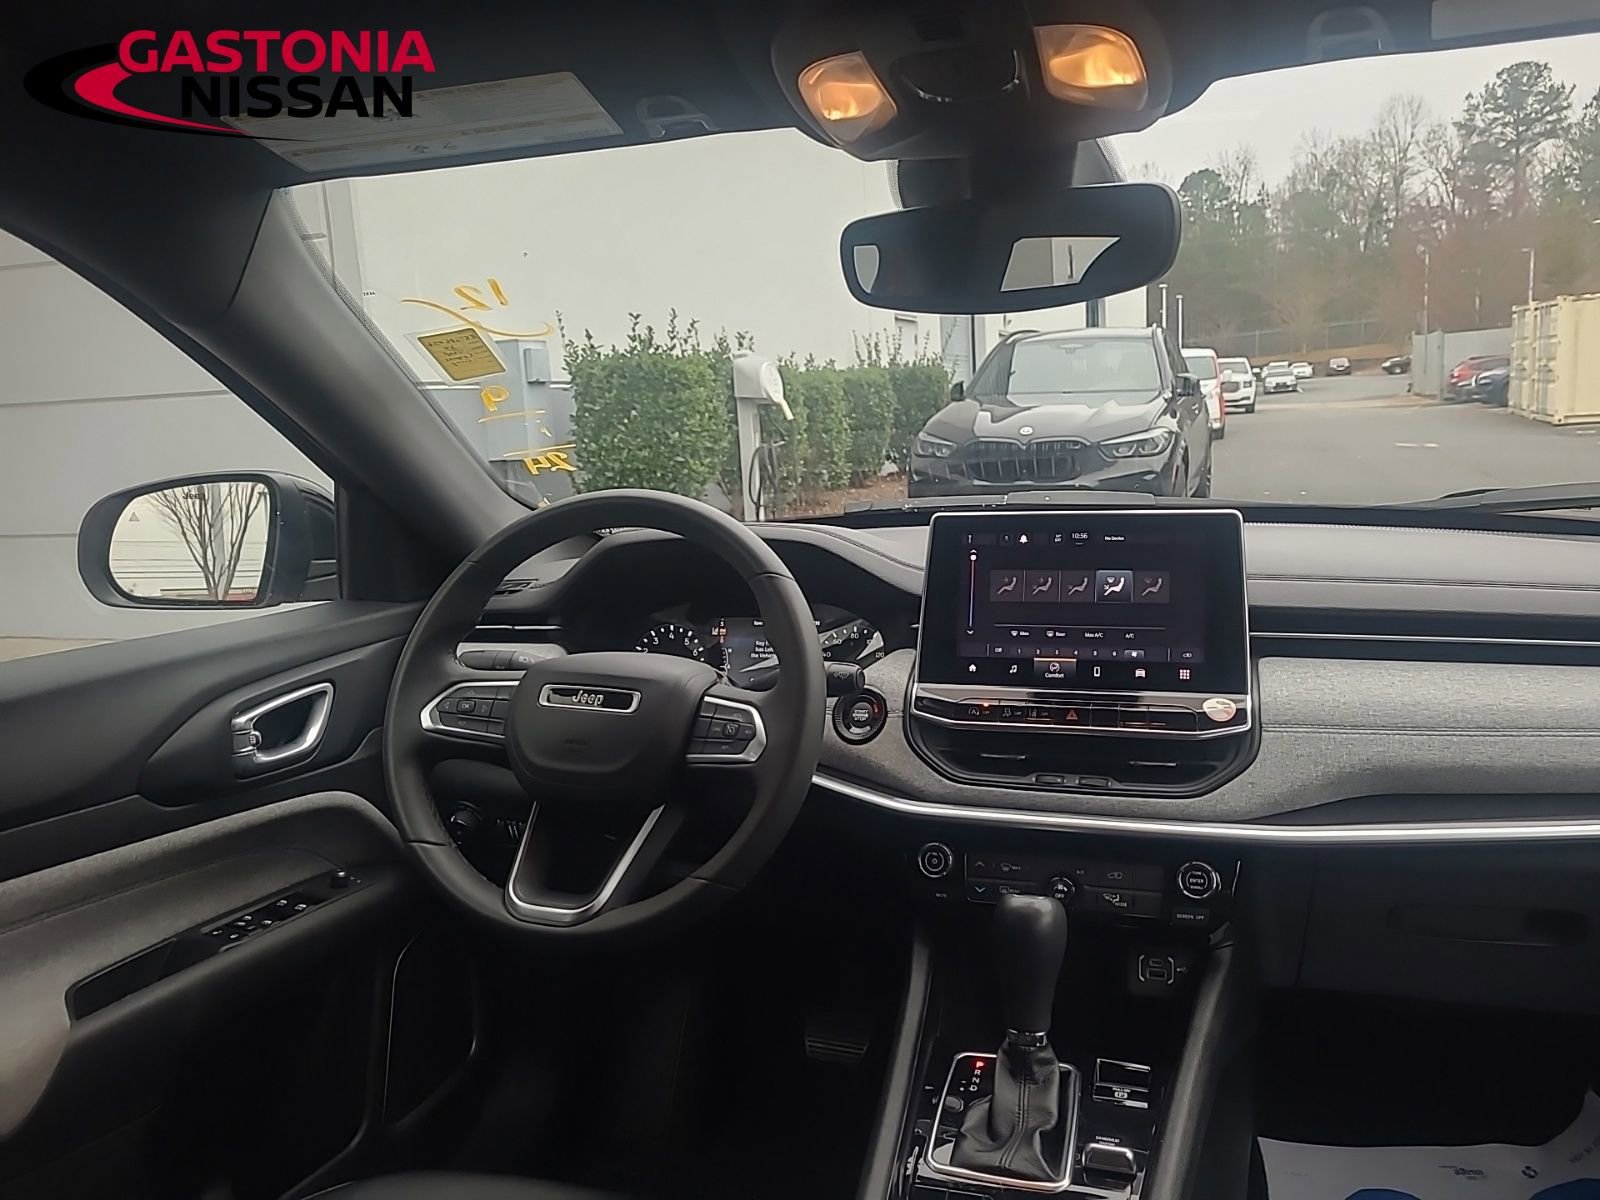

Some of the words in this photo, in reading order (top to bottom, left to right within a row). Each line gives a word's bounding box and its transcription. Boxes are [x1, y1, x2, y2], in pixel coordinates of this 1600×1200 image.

[1071, 532, 1088, 540] 10:56
[669, 632, 675, 640] 4
[652, 637, 659, 645] 3
[684, 637, 690, 646] 5
[692, 648, 698, 656] 6
[572, 690, 604, 706] Jeep
